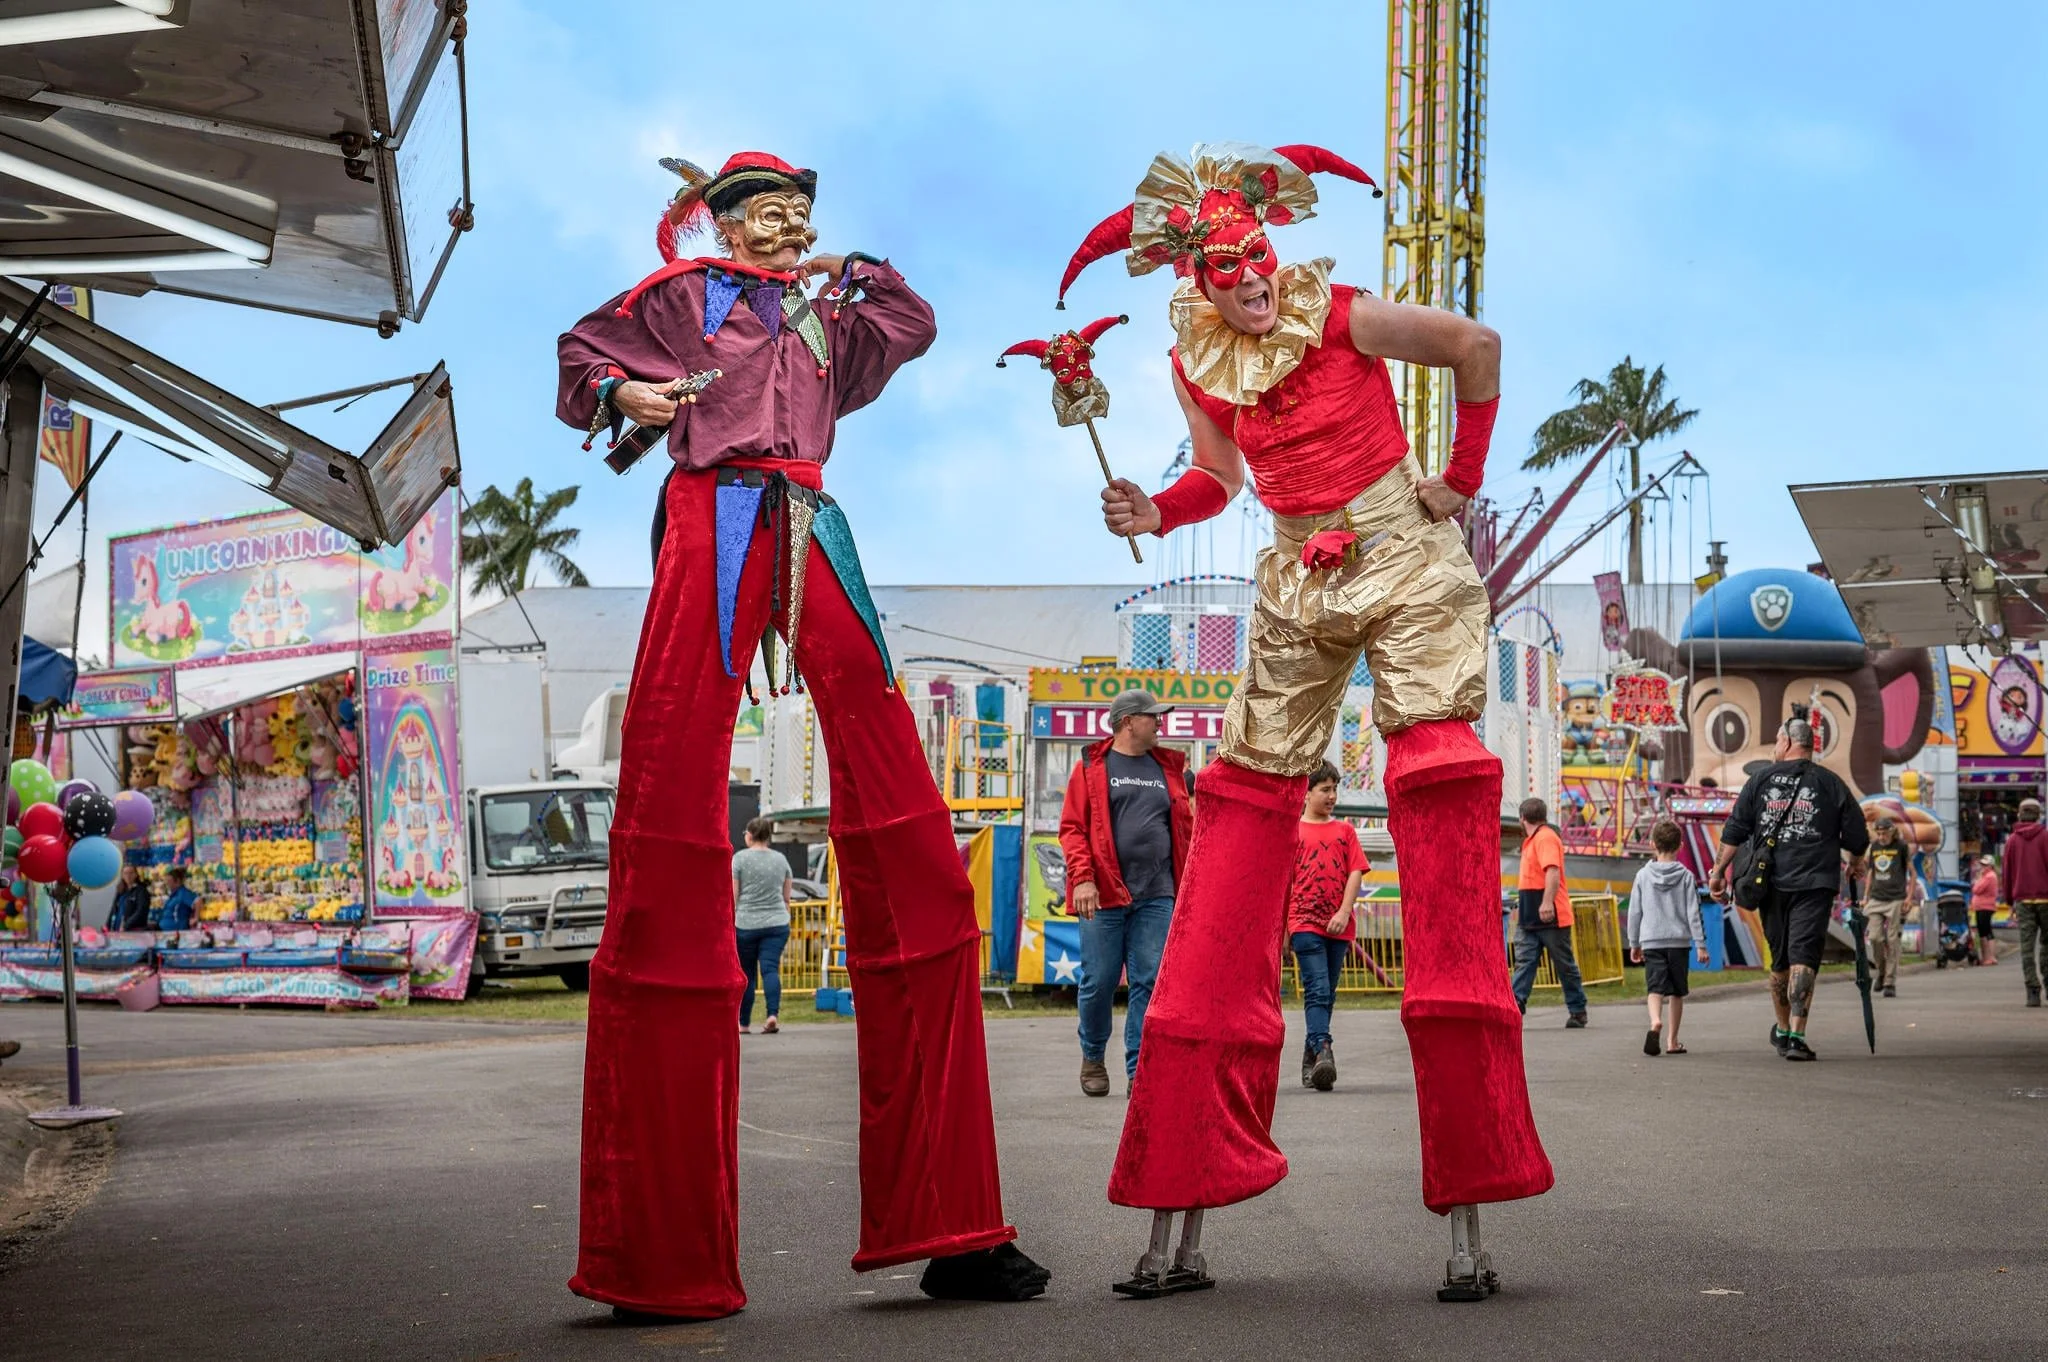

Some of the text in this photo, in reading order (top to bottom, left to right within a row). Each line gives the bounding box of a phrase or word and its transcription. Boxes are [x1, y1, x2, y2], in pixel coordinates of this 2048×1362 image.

[166, 525, 361, 579] UNICORN KINGD
[367, 661, 456, 688] Prize Time
[1080, 677, 1234, 699] TORNADO
[1615, 676, 1669, 700] STAR
